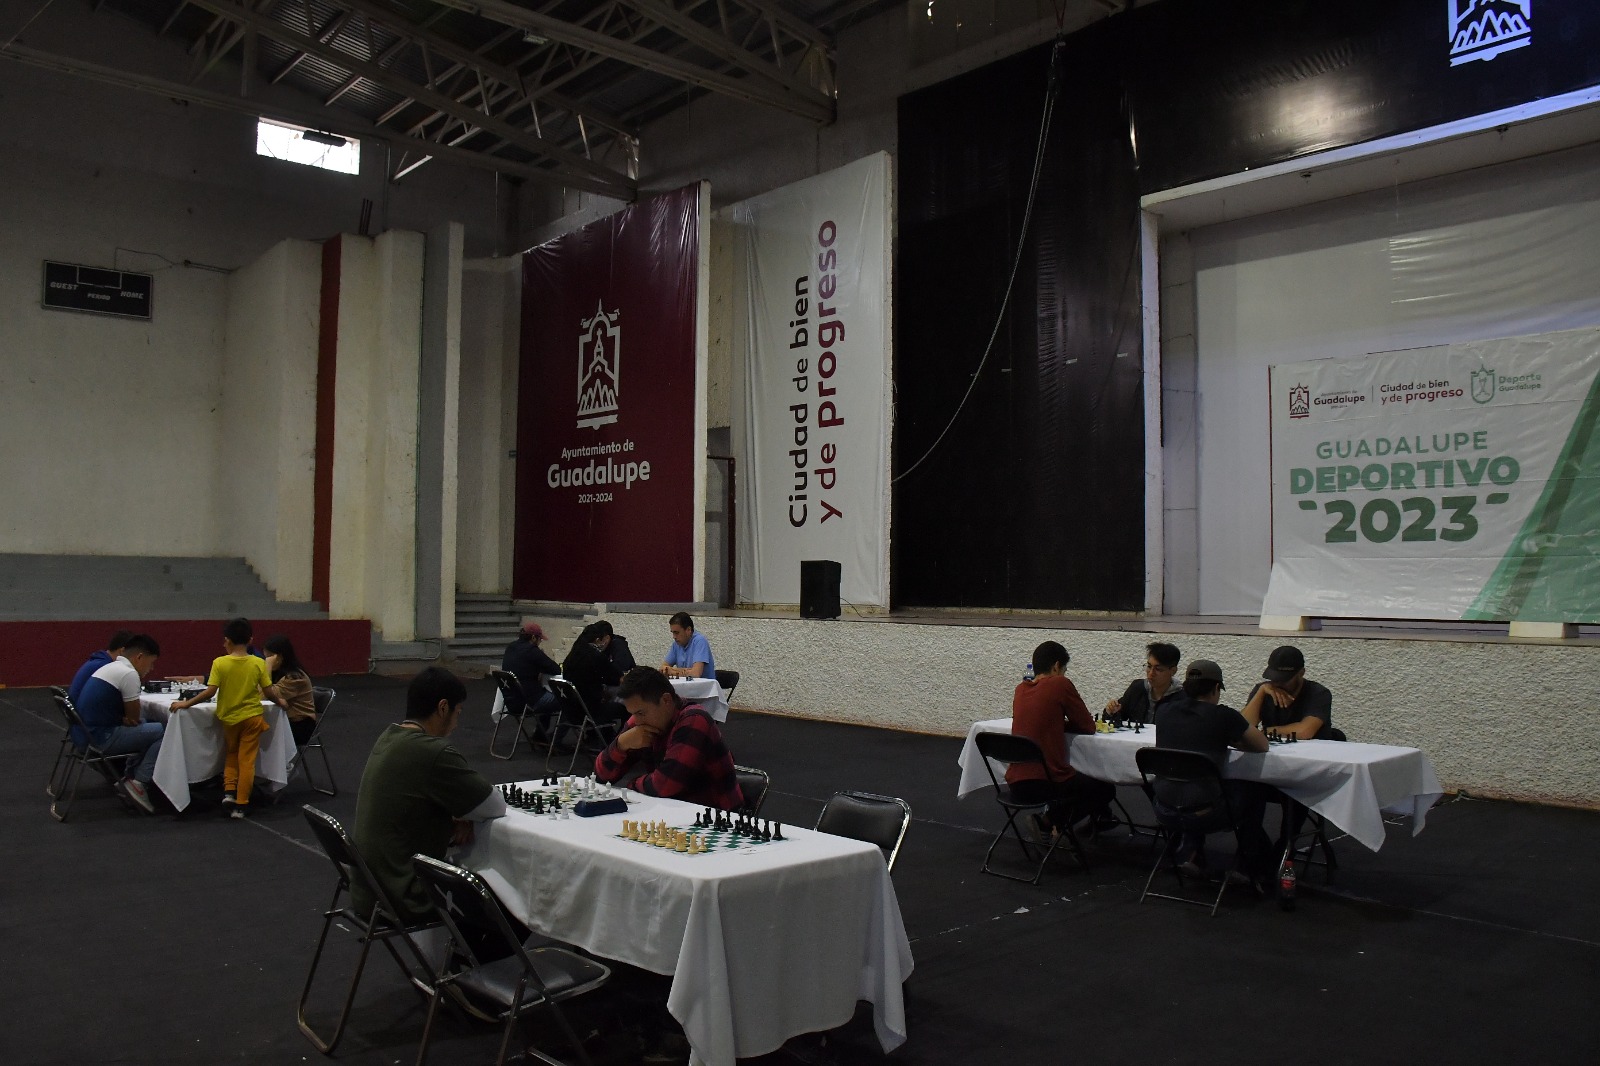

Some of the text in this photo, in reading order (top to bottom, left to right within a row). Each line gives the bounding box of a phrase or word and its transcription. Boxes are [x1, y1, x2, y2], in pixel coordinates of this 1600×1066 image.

[50, 281, 78, 290] GUEST
[814, 220, 845, 524] y de progreso
[1380, 382, 1414, 392] Ciudad
[1428, 380, 1449, 389] bien
[1381, 389, 1463, 405] y de progreso
[789, 275, 809, 528] Ciudad de bien
[1314, 395, 1365, 405] Guadalupe
[561, 439, 634, 461] Ayuntamiento de
[1316, 431, 1488, 460] GUADALUPE
[547, 457, 651, 490] Guadalupe
[1290, 456, 1521, 495] DEPORTIVO
[578, 493, 613, 504] 2021-2024
[1324, 496, 1479, 543] 2023
